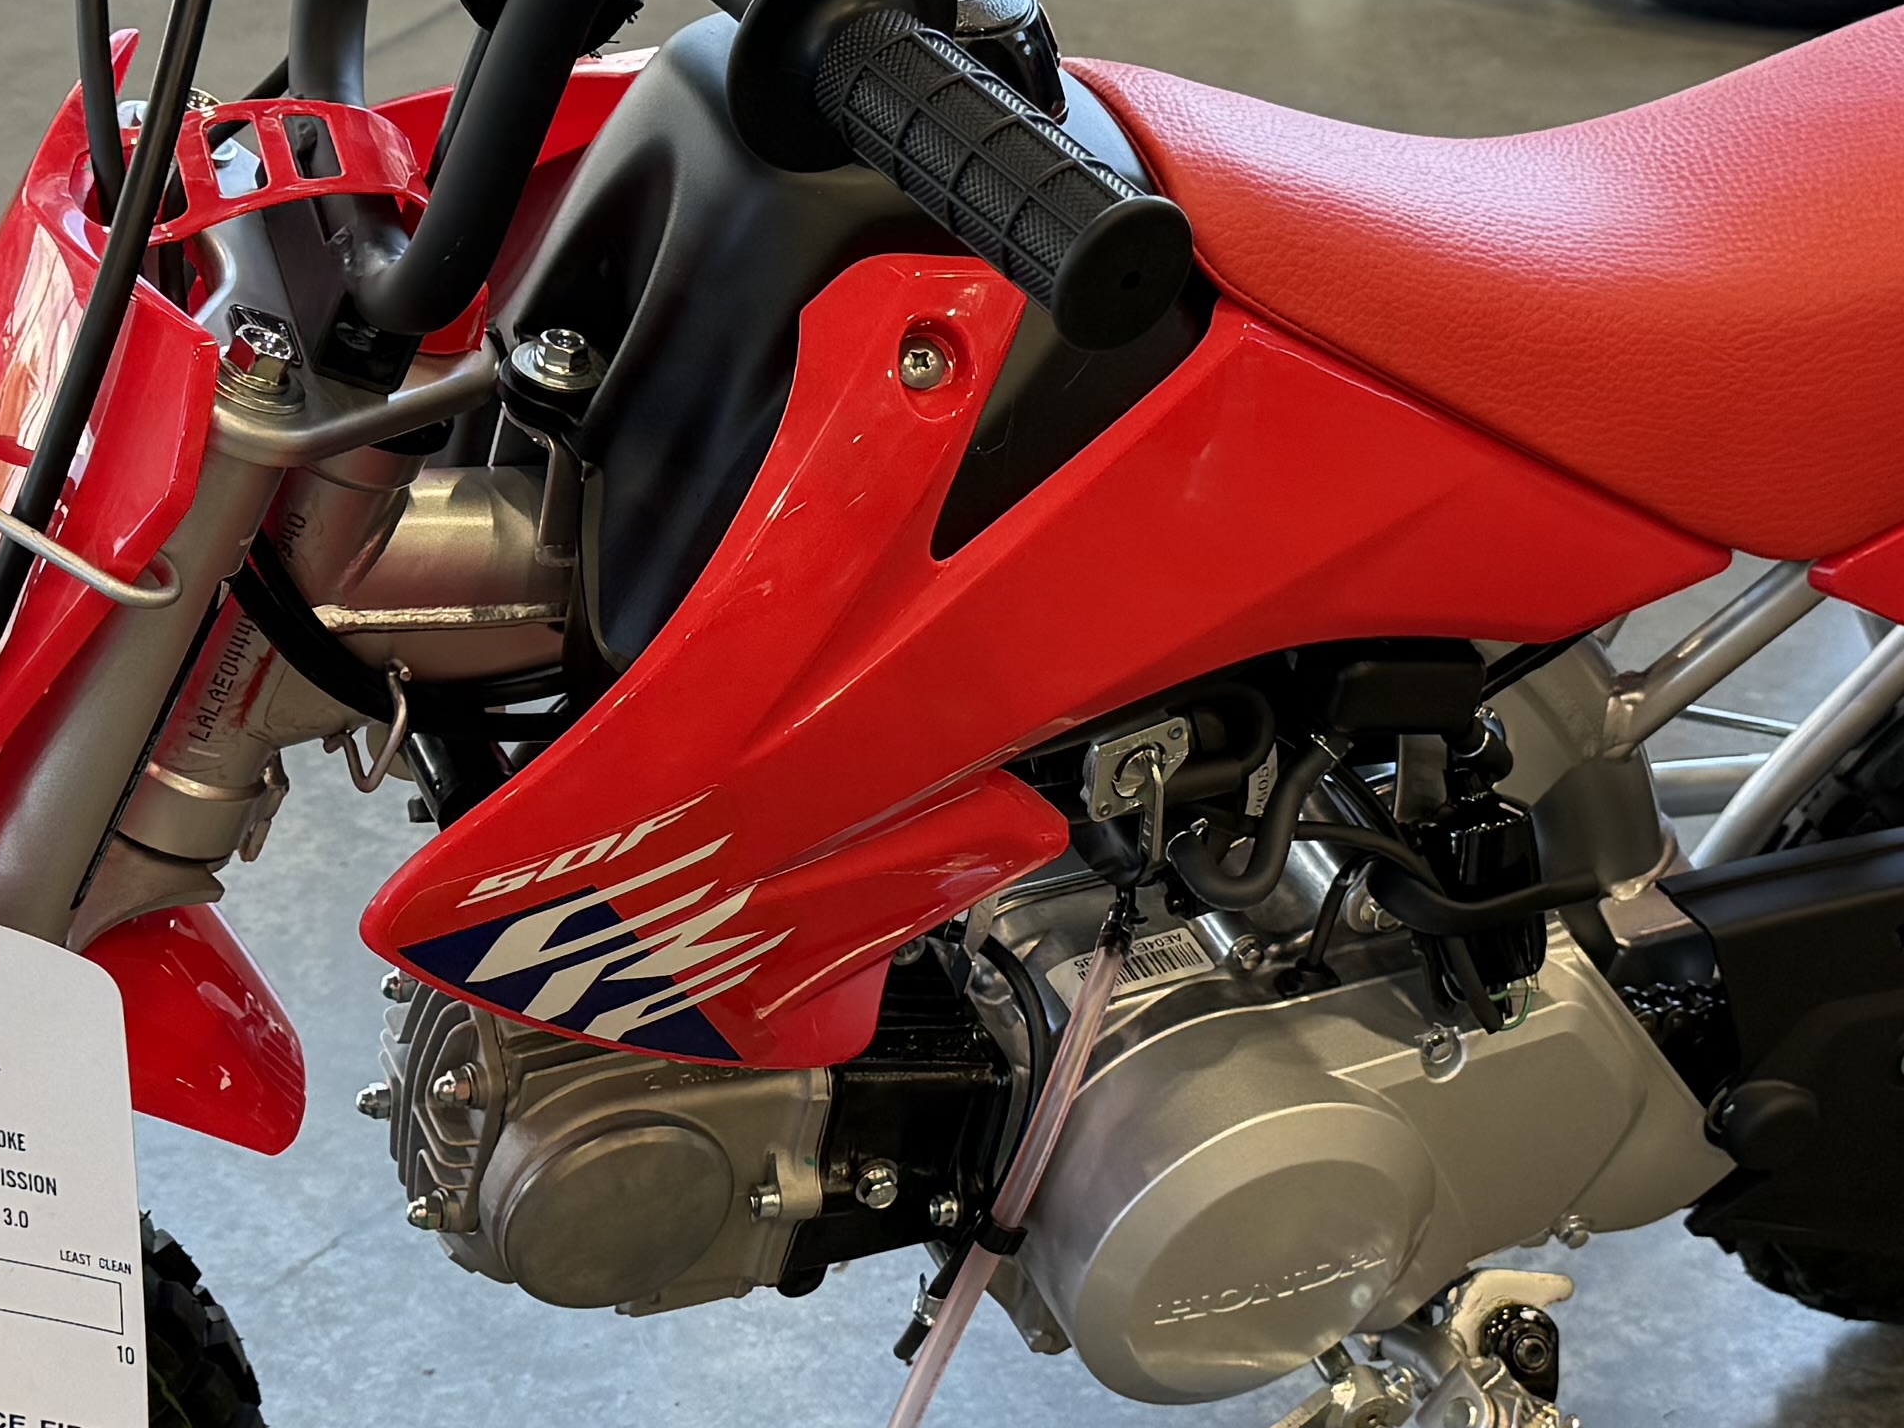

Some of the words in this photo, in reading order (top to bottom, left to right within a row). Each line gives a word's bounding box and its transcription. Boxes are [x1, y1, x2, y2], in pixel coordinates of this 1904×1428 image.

[456, 790, 713, 908] 50F
[2, 1207, 29, 1229] 3.0
[59, 1249, 91, 1267] LEAST
[98, 1257, 132, 1275] CLEAN
[1154, 1246, 1387, 1325] HONDA
[116, 1345, 135, 1365] 10
